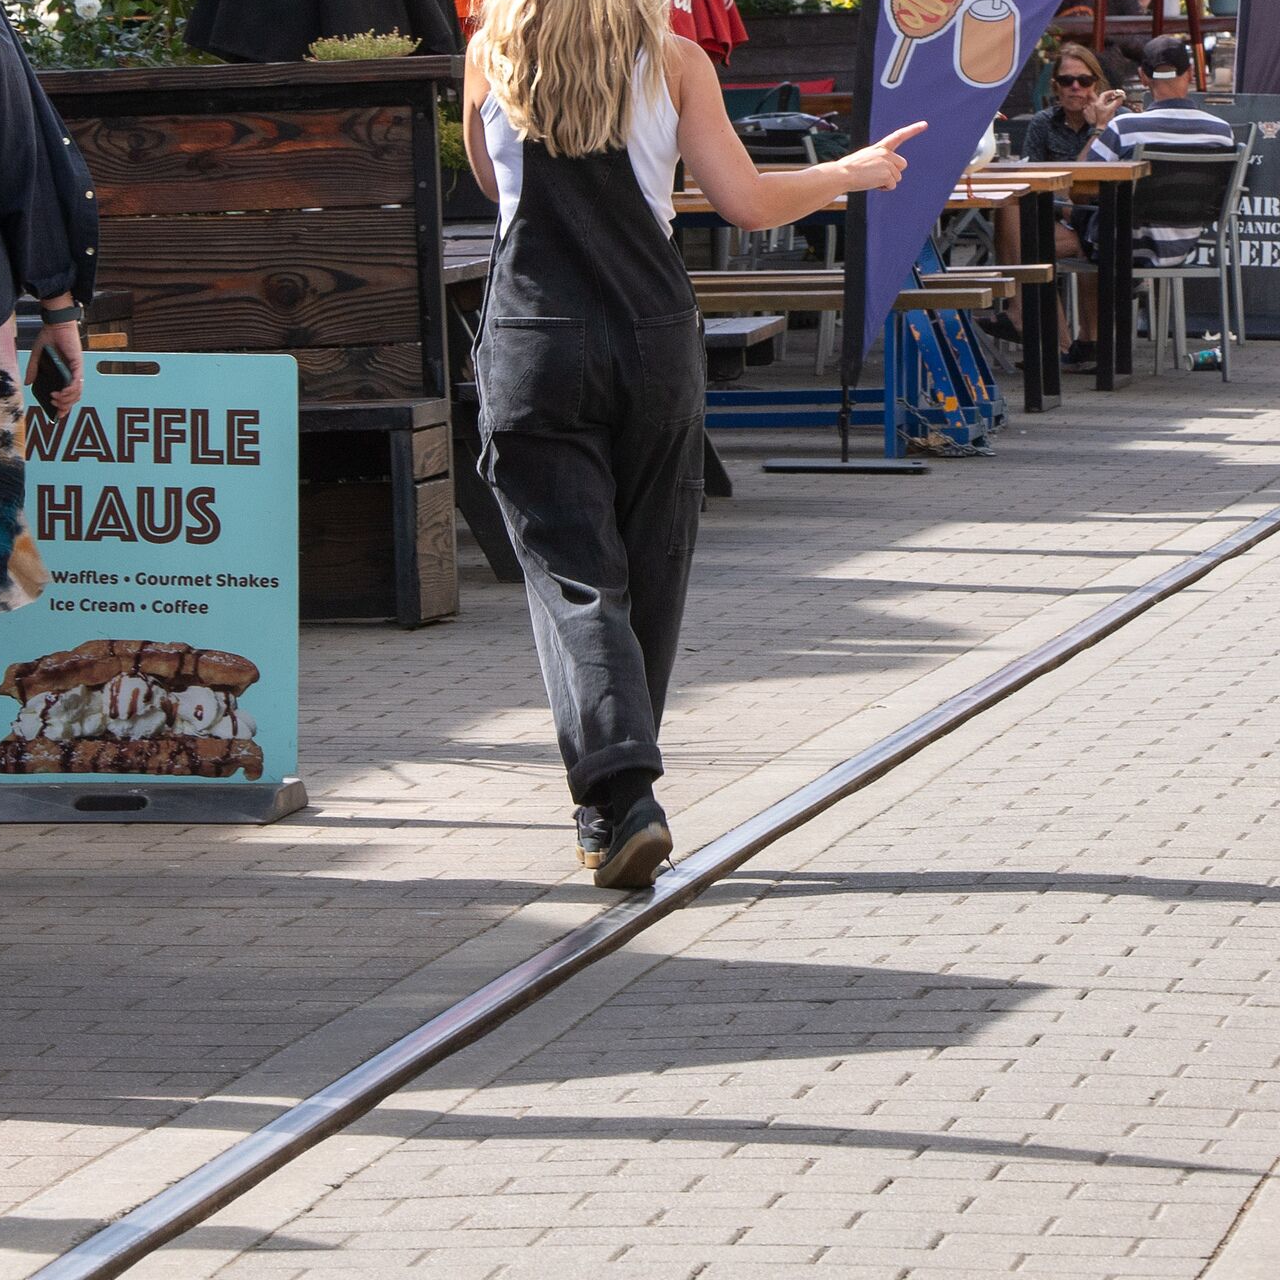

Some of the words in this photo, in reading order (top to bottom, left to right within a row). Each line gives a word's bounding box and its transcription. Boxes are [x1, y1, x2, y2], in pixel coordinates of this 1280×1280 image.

[1212, 221, 1280, 235] OGANIC
[37, 484, 221, 545] HAUS
[51, 570, 118, 585] Waffles
[135, 572, 212, 587] Gourmet
[216, 573, 279, 588] Shakes
[50, 597, 75, 611] Ice
[80, 598, 135, 613] Cream
[151, 599, 209, 614] Coffee
